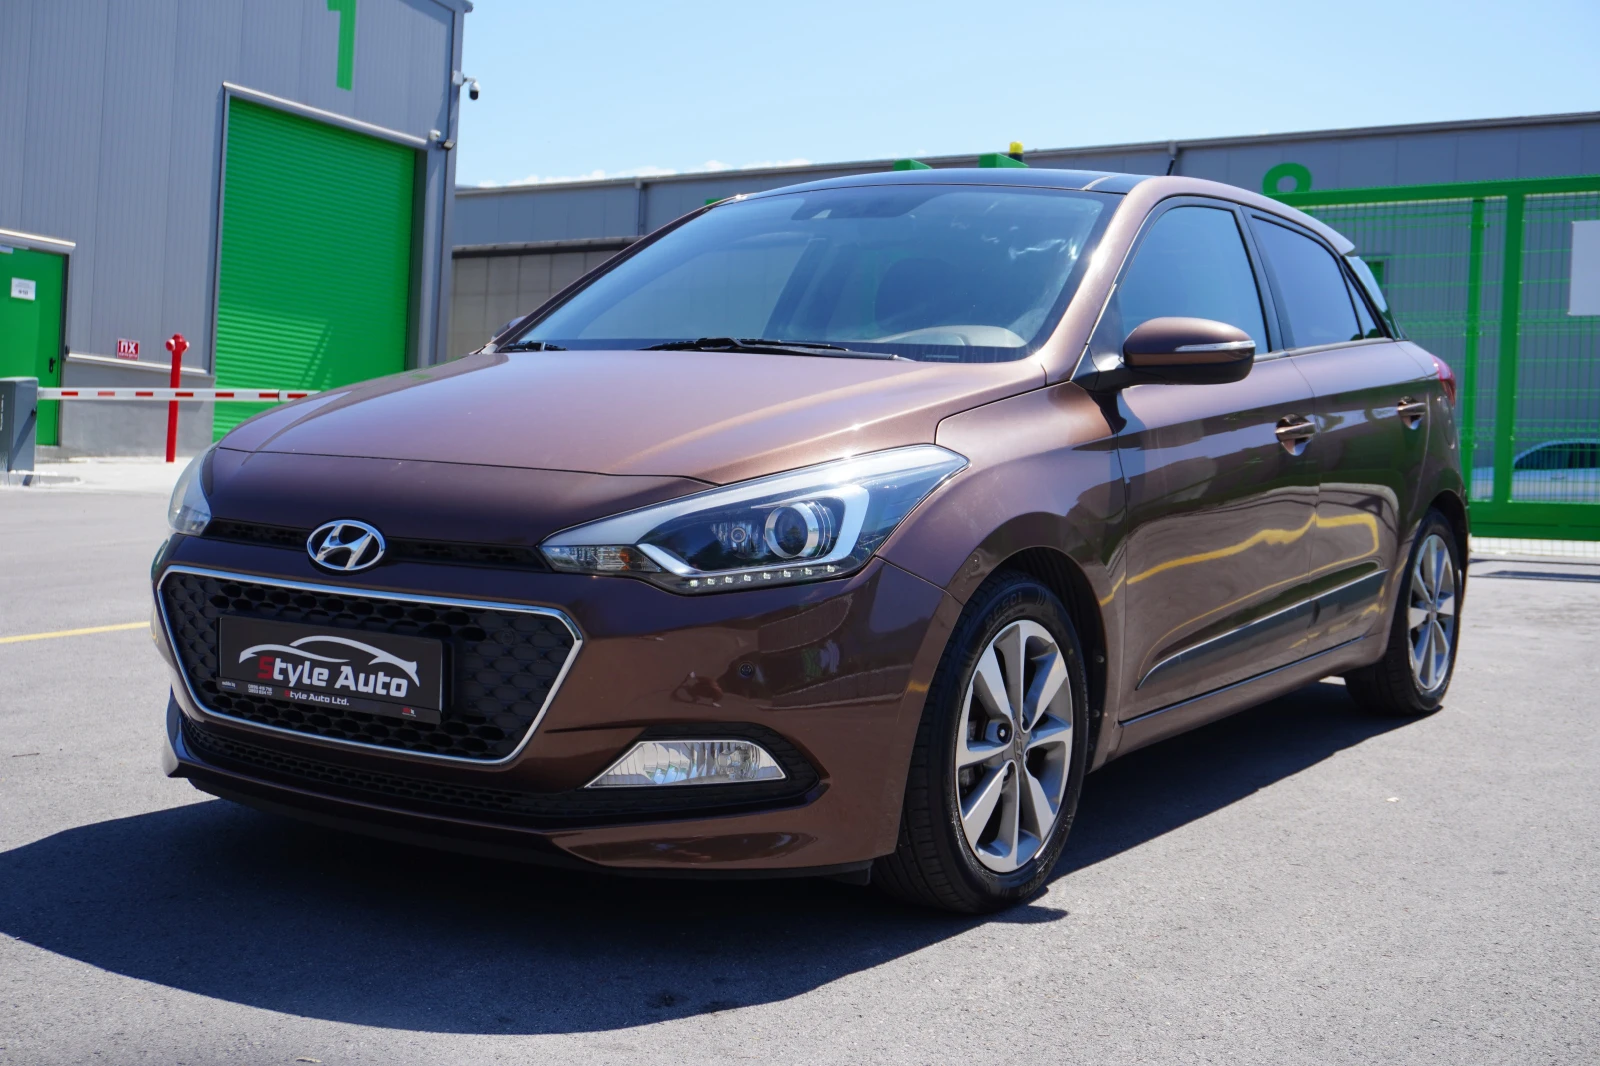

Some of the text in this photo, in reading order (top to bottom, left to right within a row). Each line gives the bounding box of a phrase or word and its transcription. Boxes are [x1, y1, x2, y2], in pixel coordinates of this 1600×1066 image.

[257, 656, 408, 698] Style Auto
[284, 690, 307, 701] Style
[308, 694, 331, 703] Auto
[331, 696, 349, 706] Ltd.
